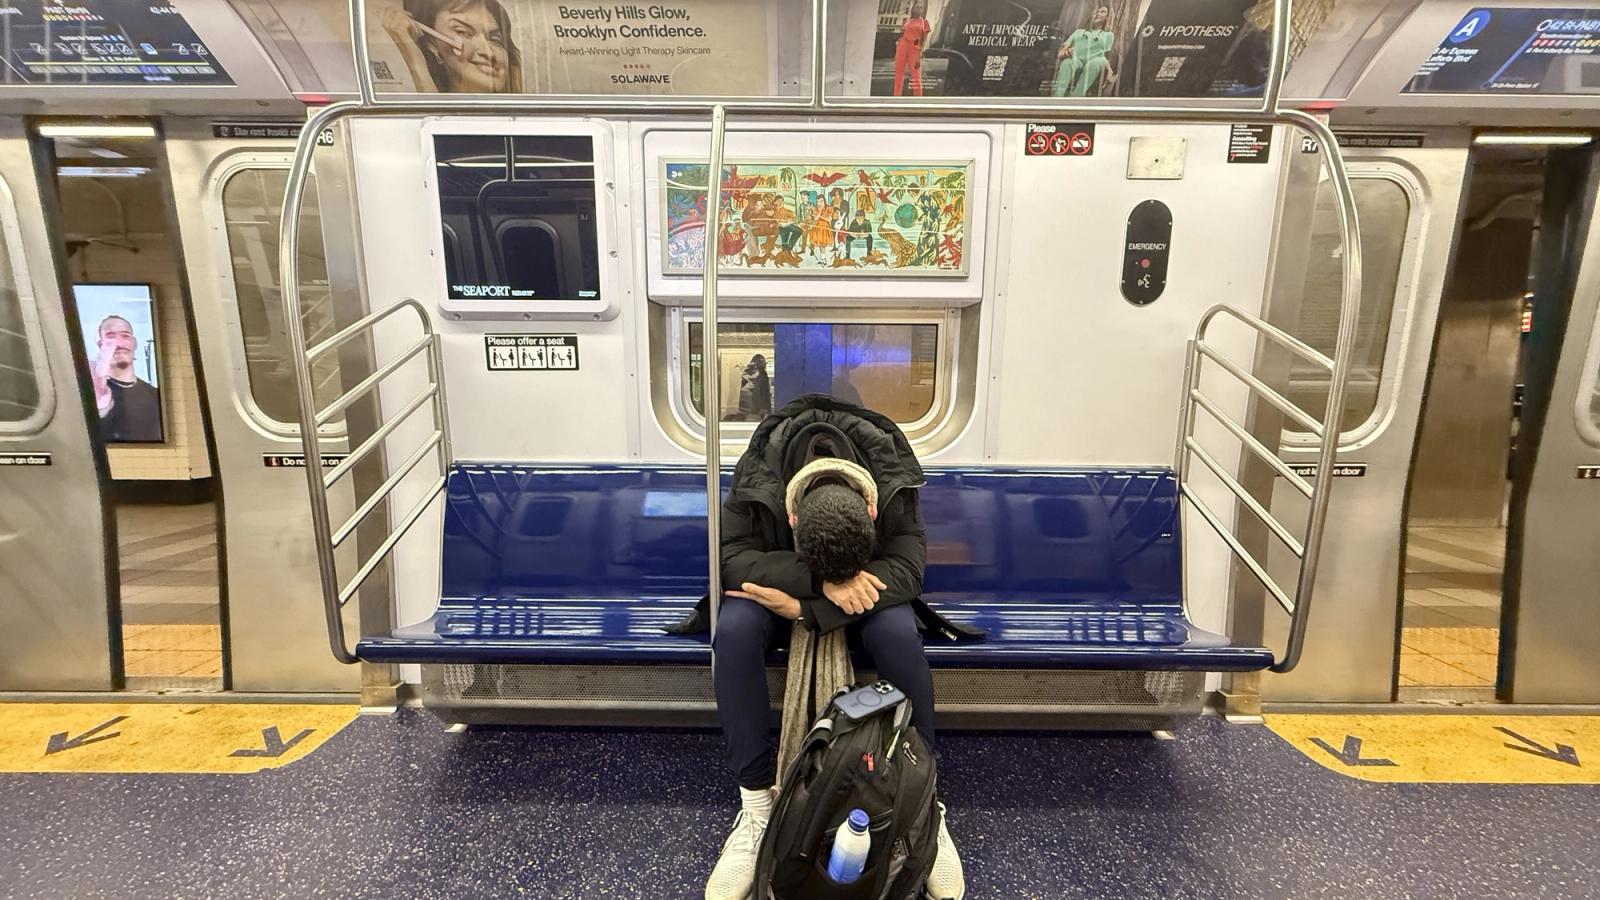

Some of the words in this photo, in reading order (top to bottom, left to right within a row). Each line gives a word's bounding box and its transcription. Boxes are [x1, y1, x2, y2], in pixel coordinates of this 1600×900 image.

[558, 5, 612, 22] Beverly
[614, 6, 646, 19] Hills
[648, 5, 690, 21] Glow,
[1159, 25, 1235, 37] HYPOTHESIS
[1454, 17, 1480, 36] A
[553, 25, 617, 41] Brooklyn
[619, 25, 707, 38] Confidence.
[967, 36, 1008, 47] MEDICAL
[559, 46, 621, 57] Award-Winning
[621, 46, 642, 56] Light
[643, 46, 675, 57] Therapy
[676, 46, 712, 55] Skincare
[611, 75, 671, 84] SOLAWAVE
[1028, 123, 1057, 133] Please
[462, 285, 511, 297] SEAPORT
[487, 336, 516, 346] Please
[517, 336, 538, 346] offer
[538, 338, 546, 346] a
[546, 337, 565, 346] seat
[27, 456, 46, 464] door
[282, 457, 295, 466] Do
[1340, 467, 1361, 475] door
